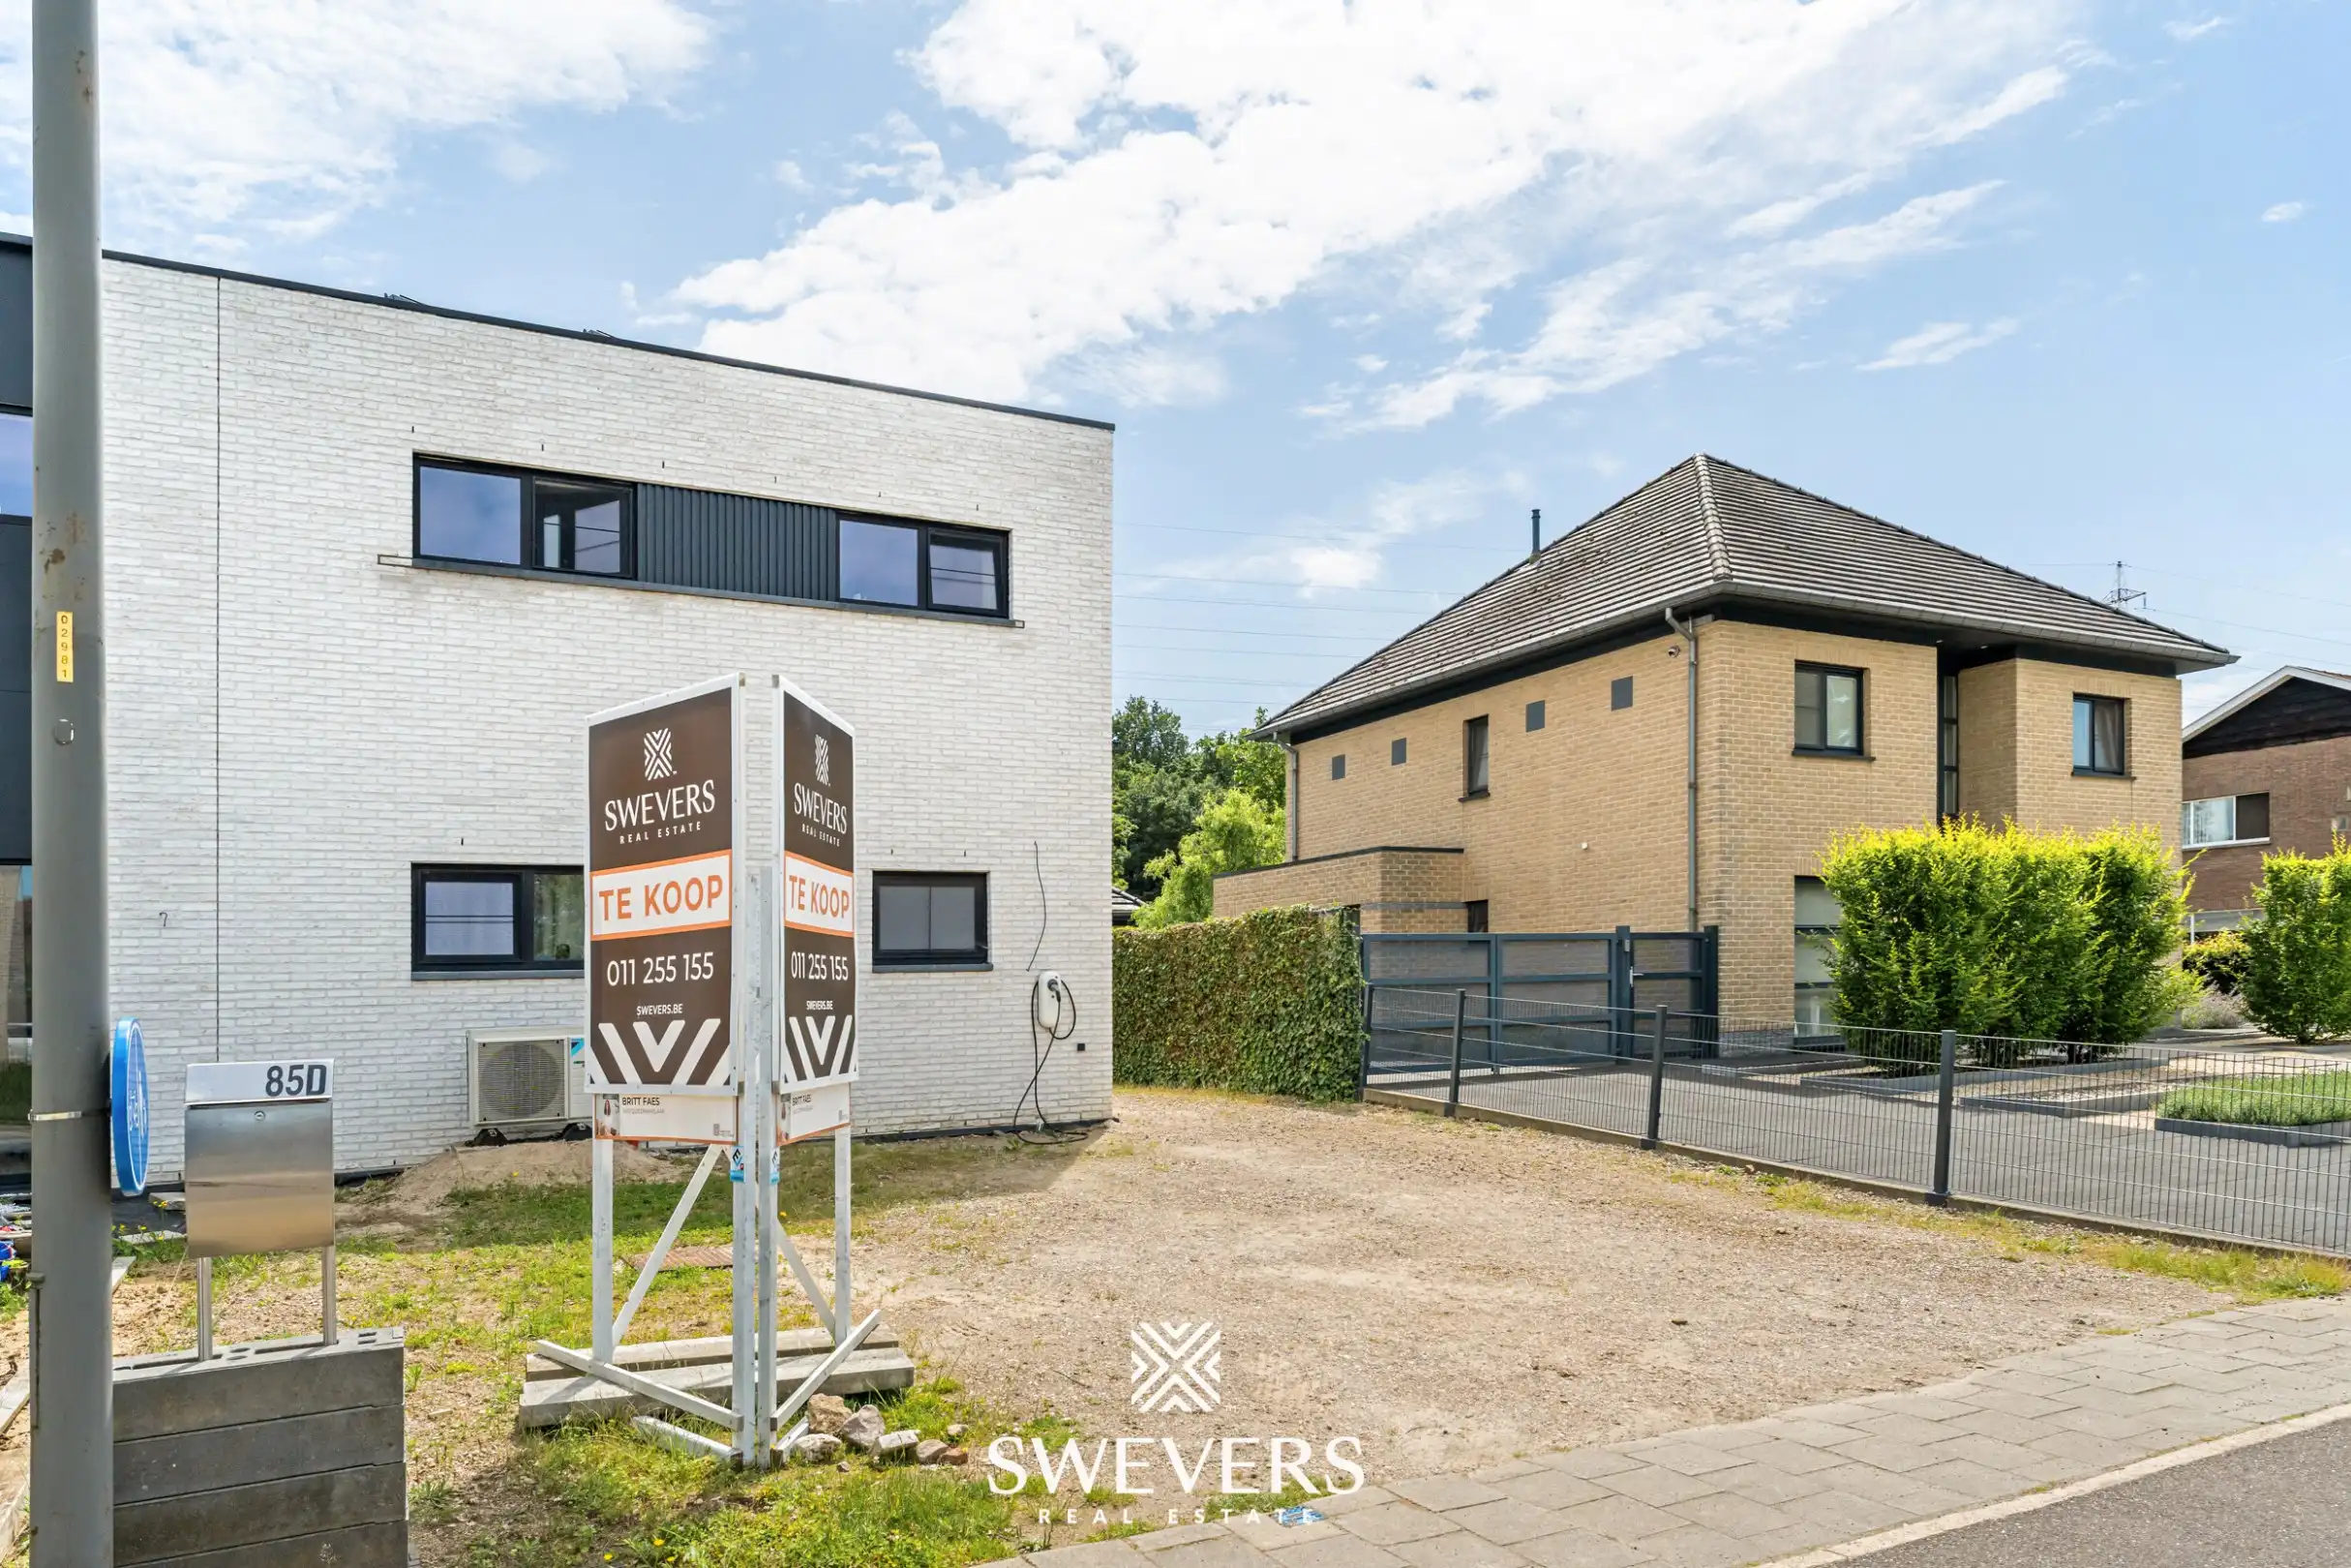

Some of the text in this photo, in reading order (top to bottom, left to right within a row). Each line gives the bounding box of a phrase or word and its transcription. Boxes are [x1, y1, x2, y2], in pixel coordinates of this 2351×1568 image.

[60, 615, 69, 678] 02981
[604, 779, 716, 831] SWEVERS
[794, 782, 848, 835] SWEVERS
[619, 821, 702, 845] REAL ESTATE
[801, 823, 841, 848] REAL ESTATE
[598, 874, 724, 921] TE KOOP
[789, 875, 850, 919] TE KOOP
[606, 951, 714, 987] 011 255 155
[791, 950, 849, 981] 011 255 155
[636, 1003, 683, 1016] SWEVERS.BE
[265, 1064, 327, 1097] 85D
[621, 1097, 660, 1106] BRITT FAES
